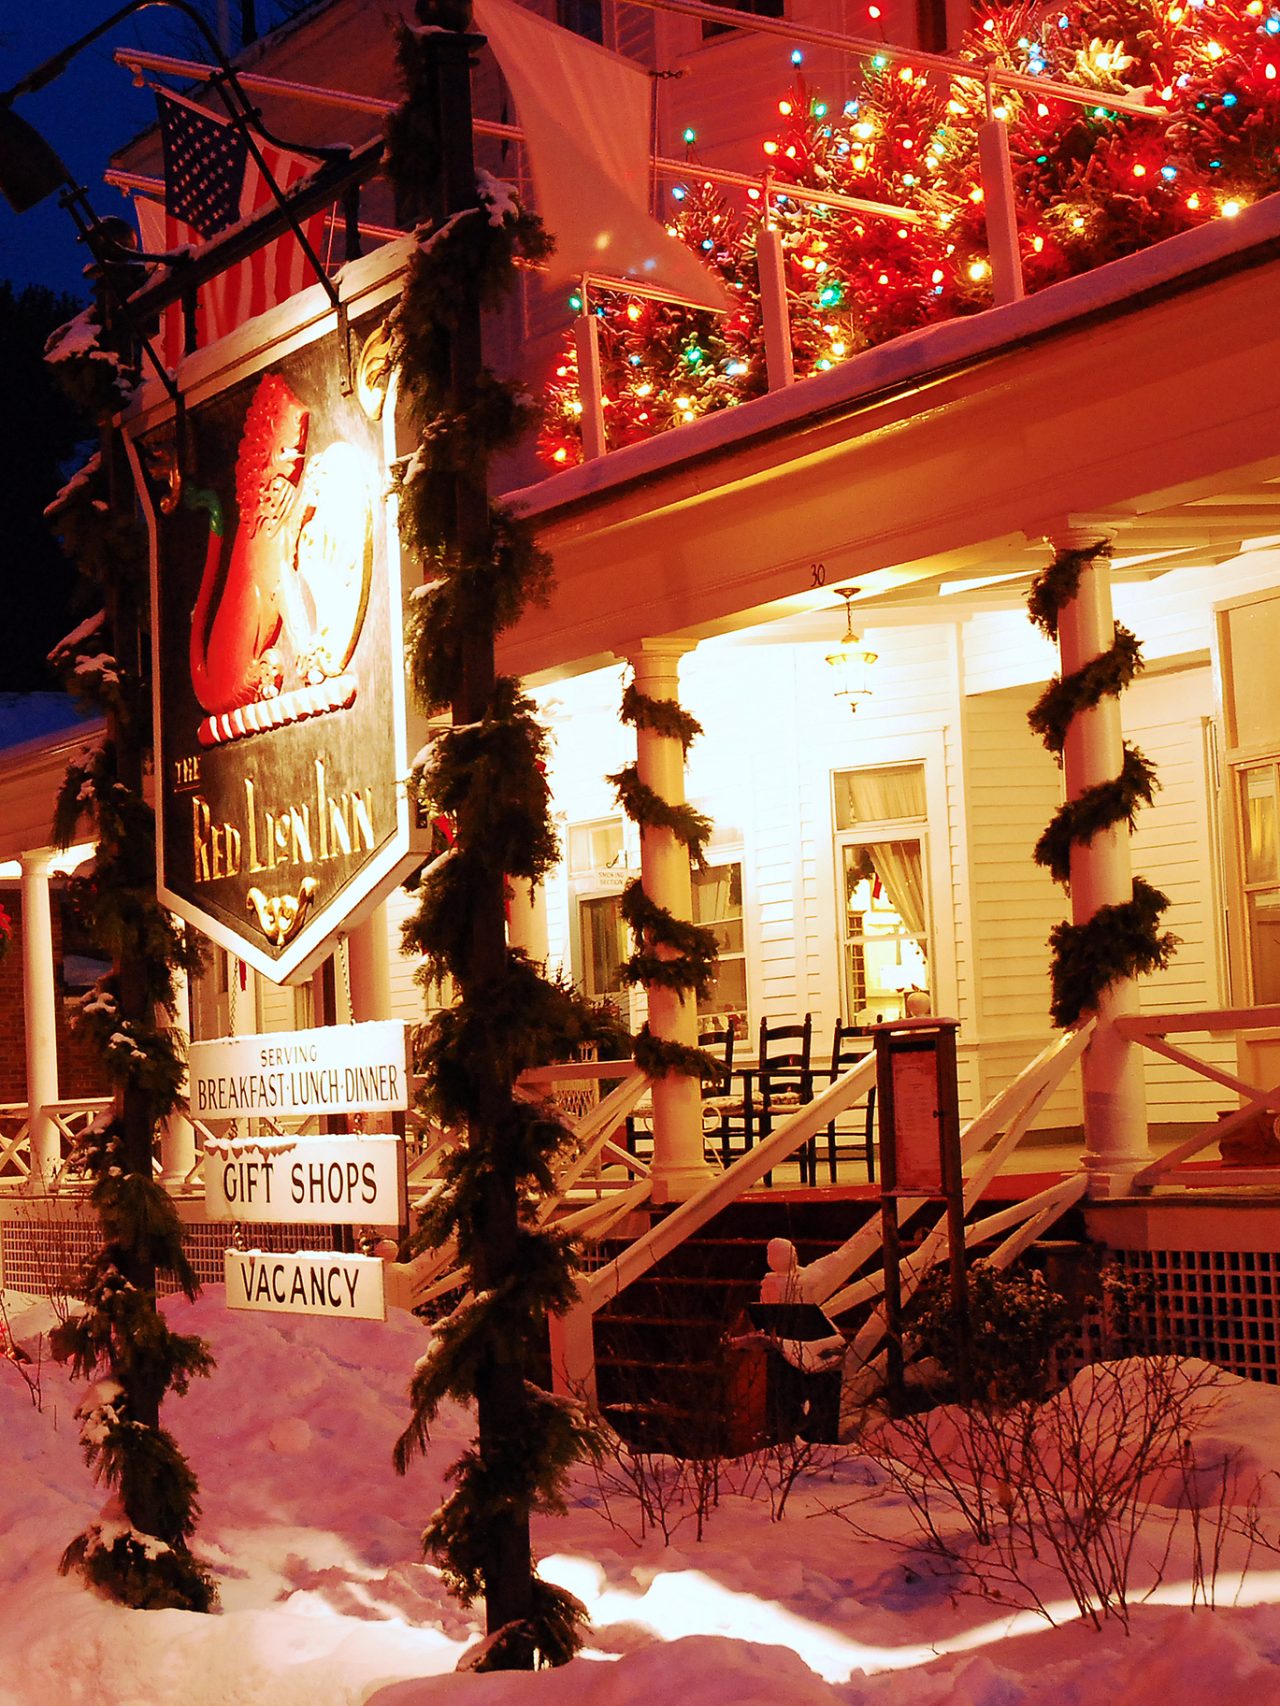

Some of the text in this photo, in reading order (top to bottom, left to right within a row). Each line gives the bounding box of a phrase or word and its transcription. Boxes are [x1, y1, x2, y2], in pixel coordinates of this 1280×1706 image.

[810, 564, 826, 588] 30
[174, 755, 202, 784] THE
[192, 759, 375, 883] RED LION INN
[260, 1045, 318, 1067] SERVING
[198, 1064, 399, 1110] BREAKFAST LUNCH DINNER
[223, 1162, 377, 1204] GIFT SHOPS
[240, 1263, 360, 1308] VACANCY
